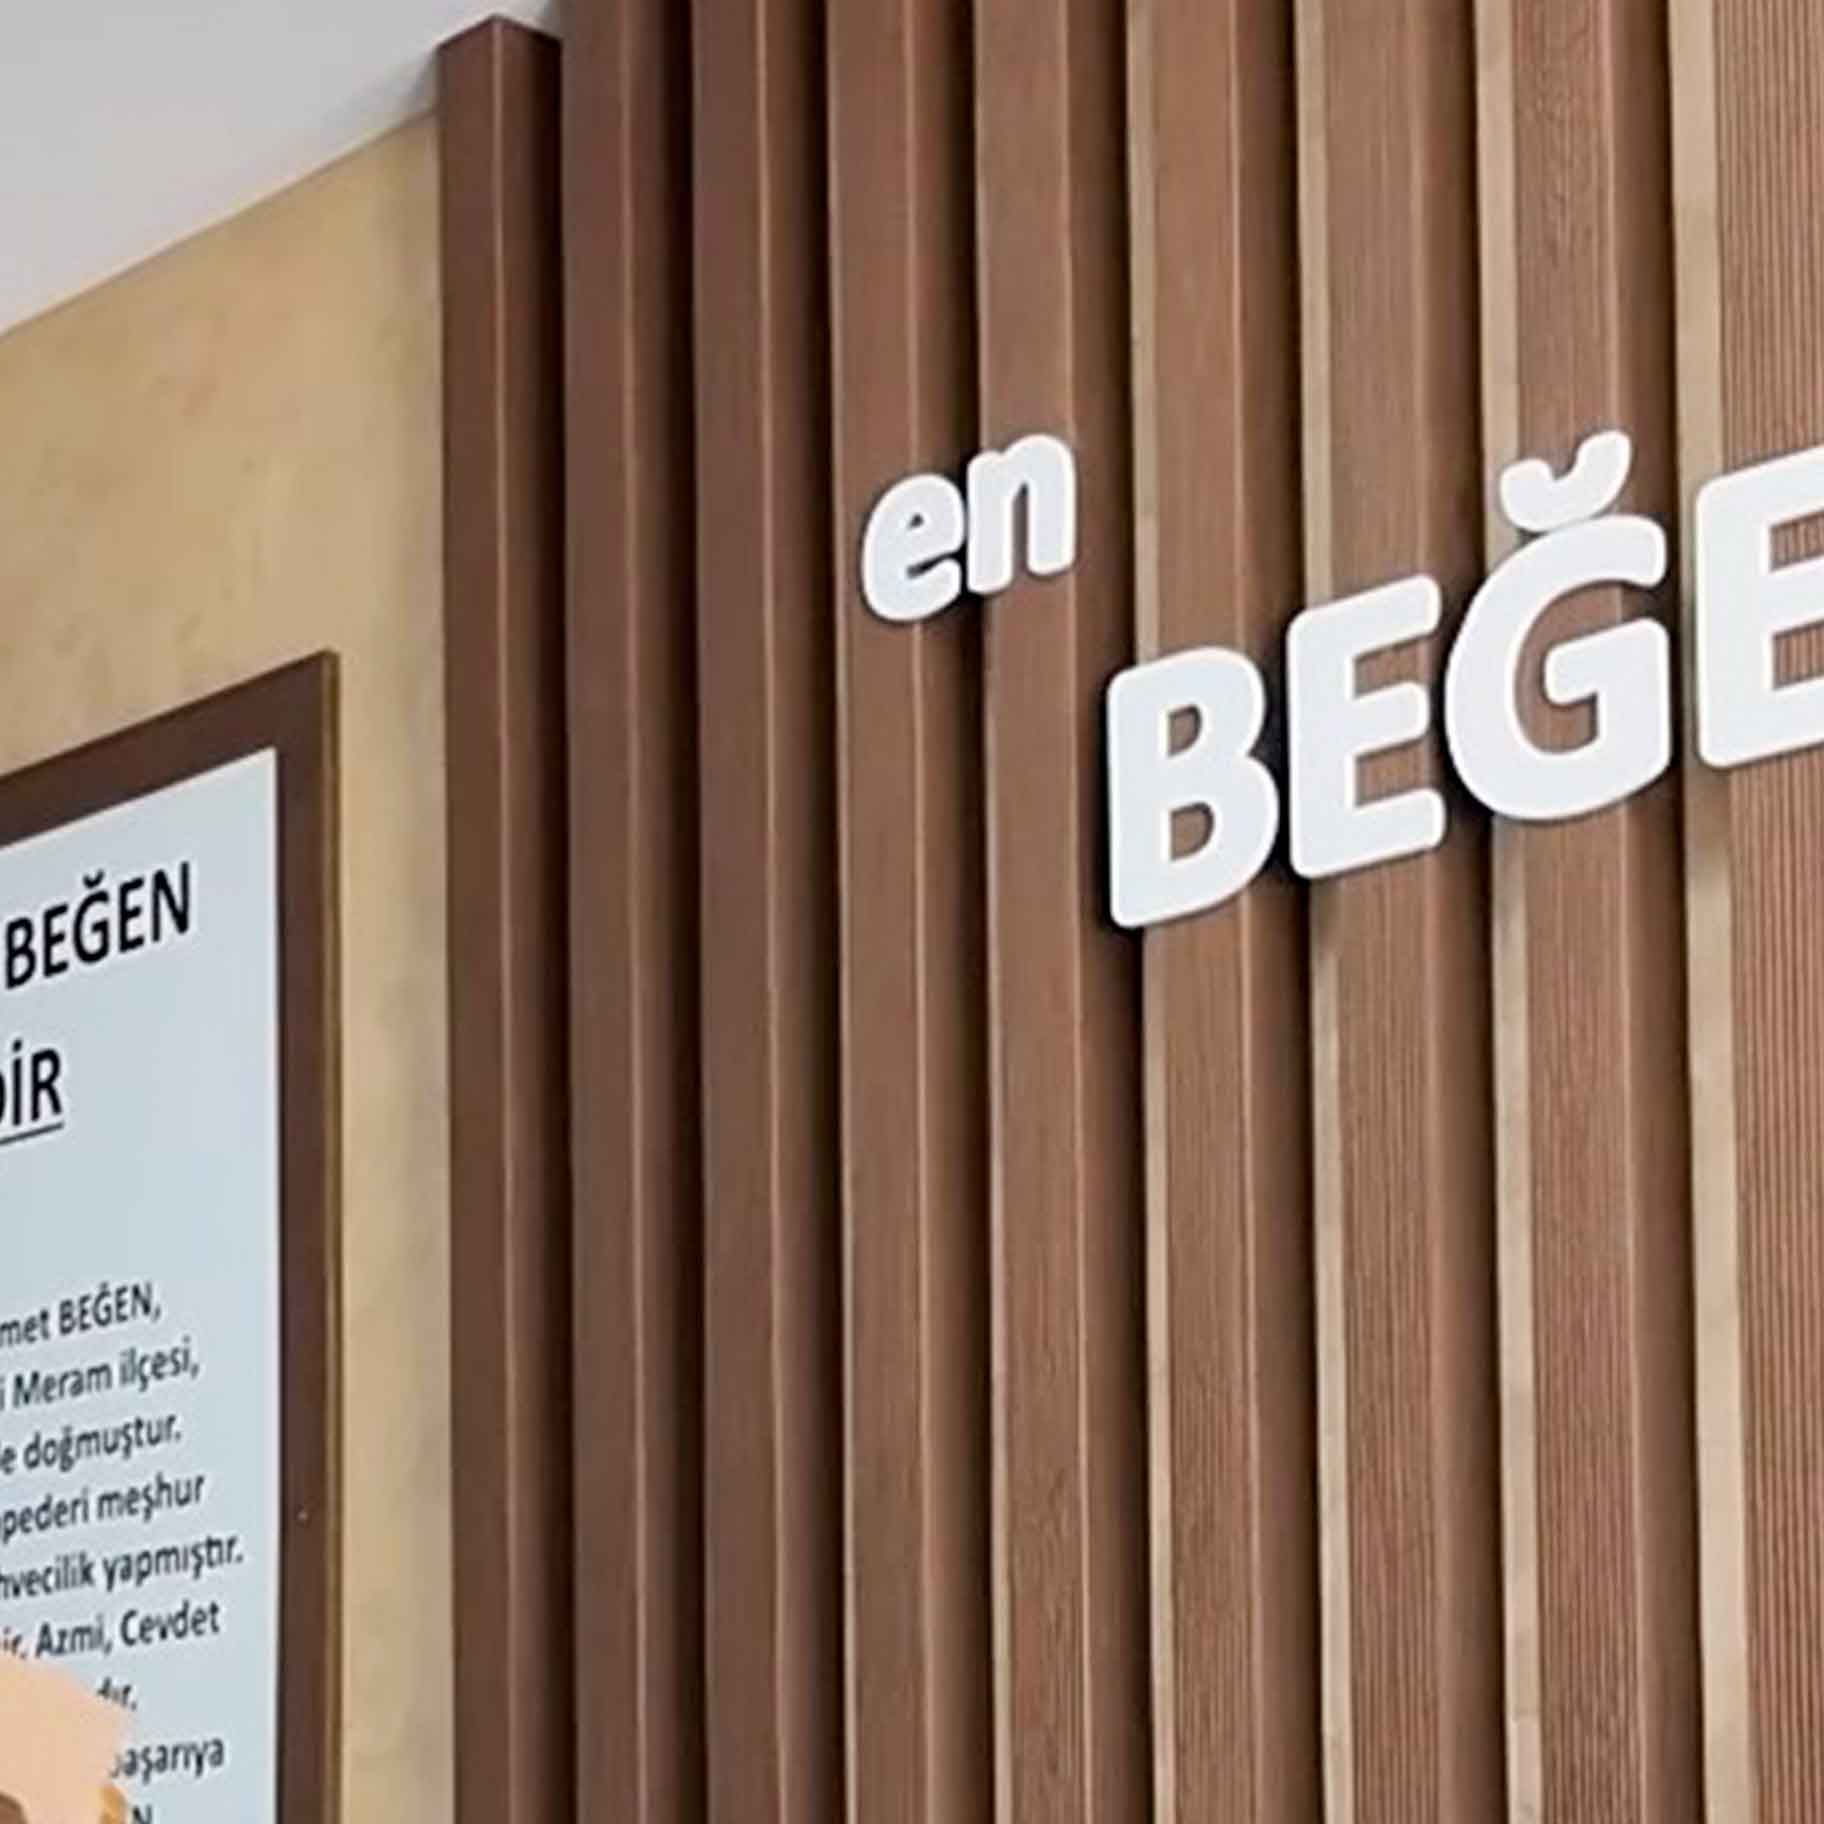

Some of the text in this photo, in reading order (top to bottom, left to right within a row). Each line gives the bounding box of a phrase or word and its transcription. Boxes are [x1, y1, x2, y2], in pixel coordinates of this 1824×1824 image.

[862, 433, 1076, 621] en
[3, 861, 191, 990] BEĞEN
[58, 1282, 162, 1336] BEĞEN,
[12, 1362, 113, 1409] Meram
[118, 1334, 200, 1392] ilçesi,
[23, 1414, 182, 1473] doğmuştur.
[96, 1472, 205, 1524] meşhur
[102, 1535, 244, 1592] yapmıştır.
[35, 1613, 113, 1659] Azmi,
[120, 1598, 221, 1647] Cevdet
